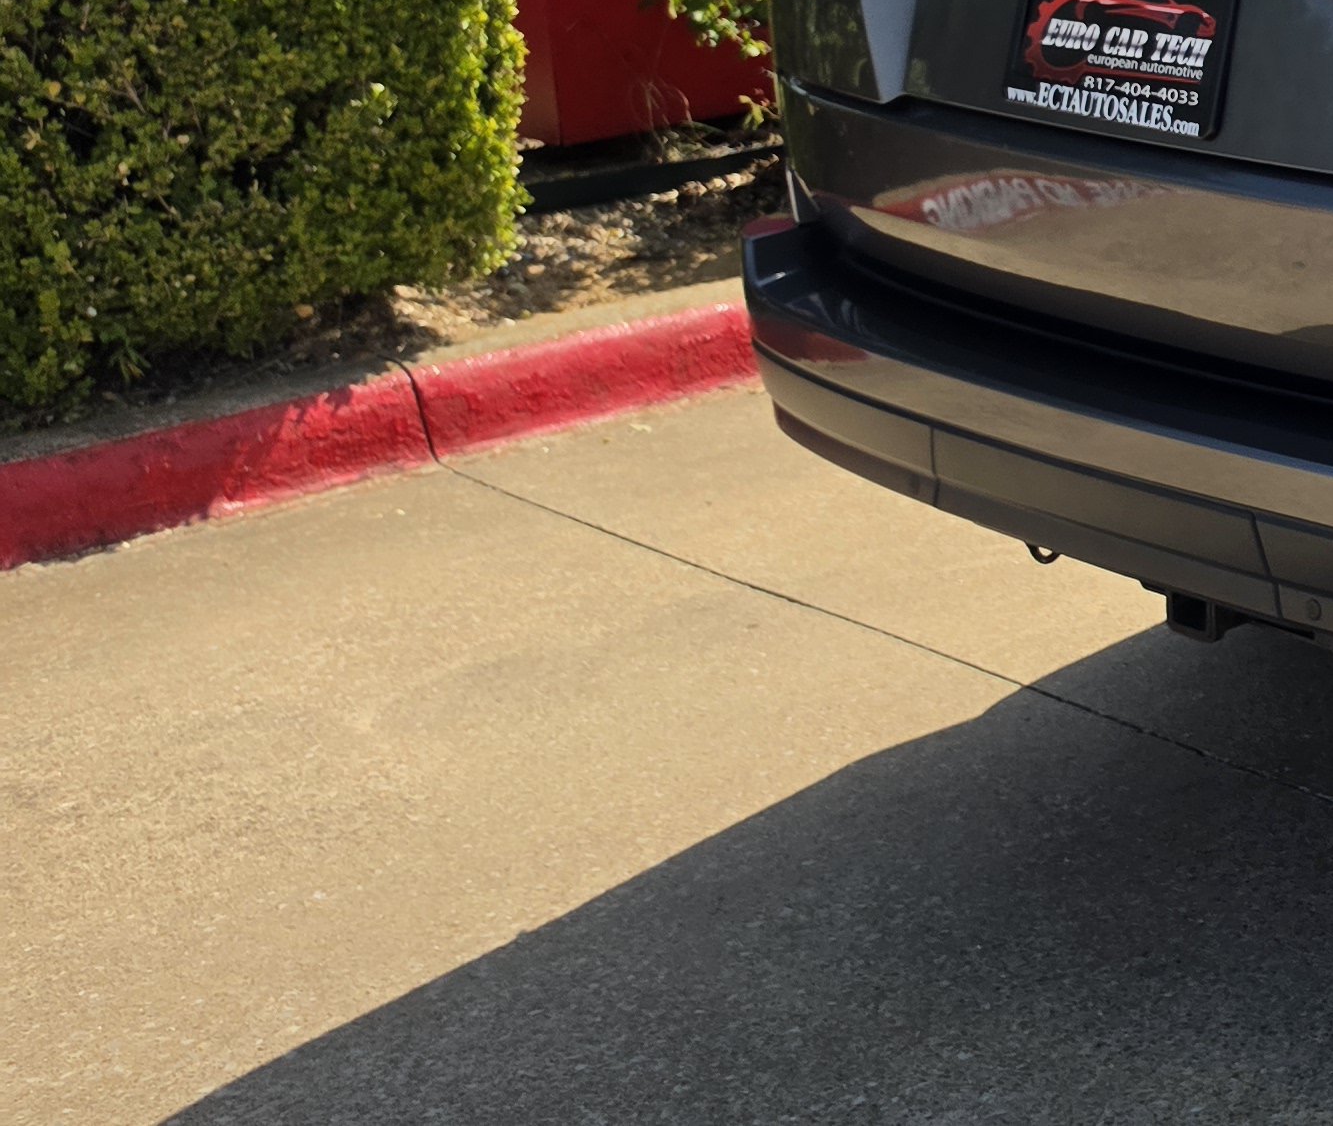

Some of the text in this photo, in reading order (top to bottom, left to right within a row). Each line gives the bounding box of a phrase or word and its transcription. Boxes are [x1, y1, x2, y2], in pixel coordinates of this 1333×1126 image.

[1041, 18, 1213, 68] EURO CAR TECH
[1087, 53, 1203, 80] european automotive
[1007, 82, 1200, 137] www.ECTAUTOSALES.com
[1084, 76, 1199, 106] 817-404-4033
